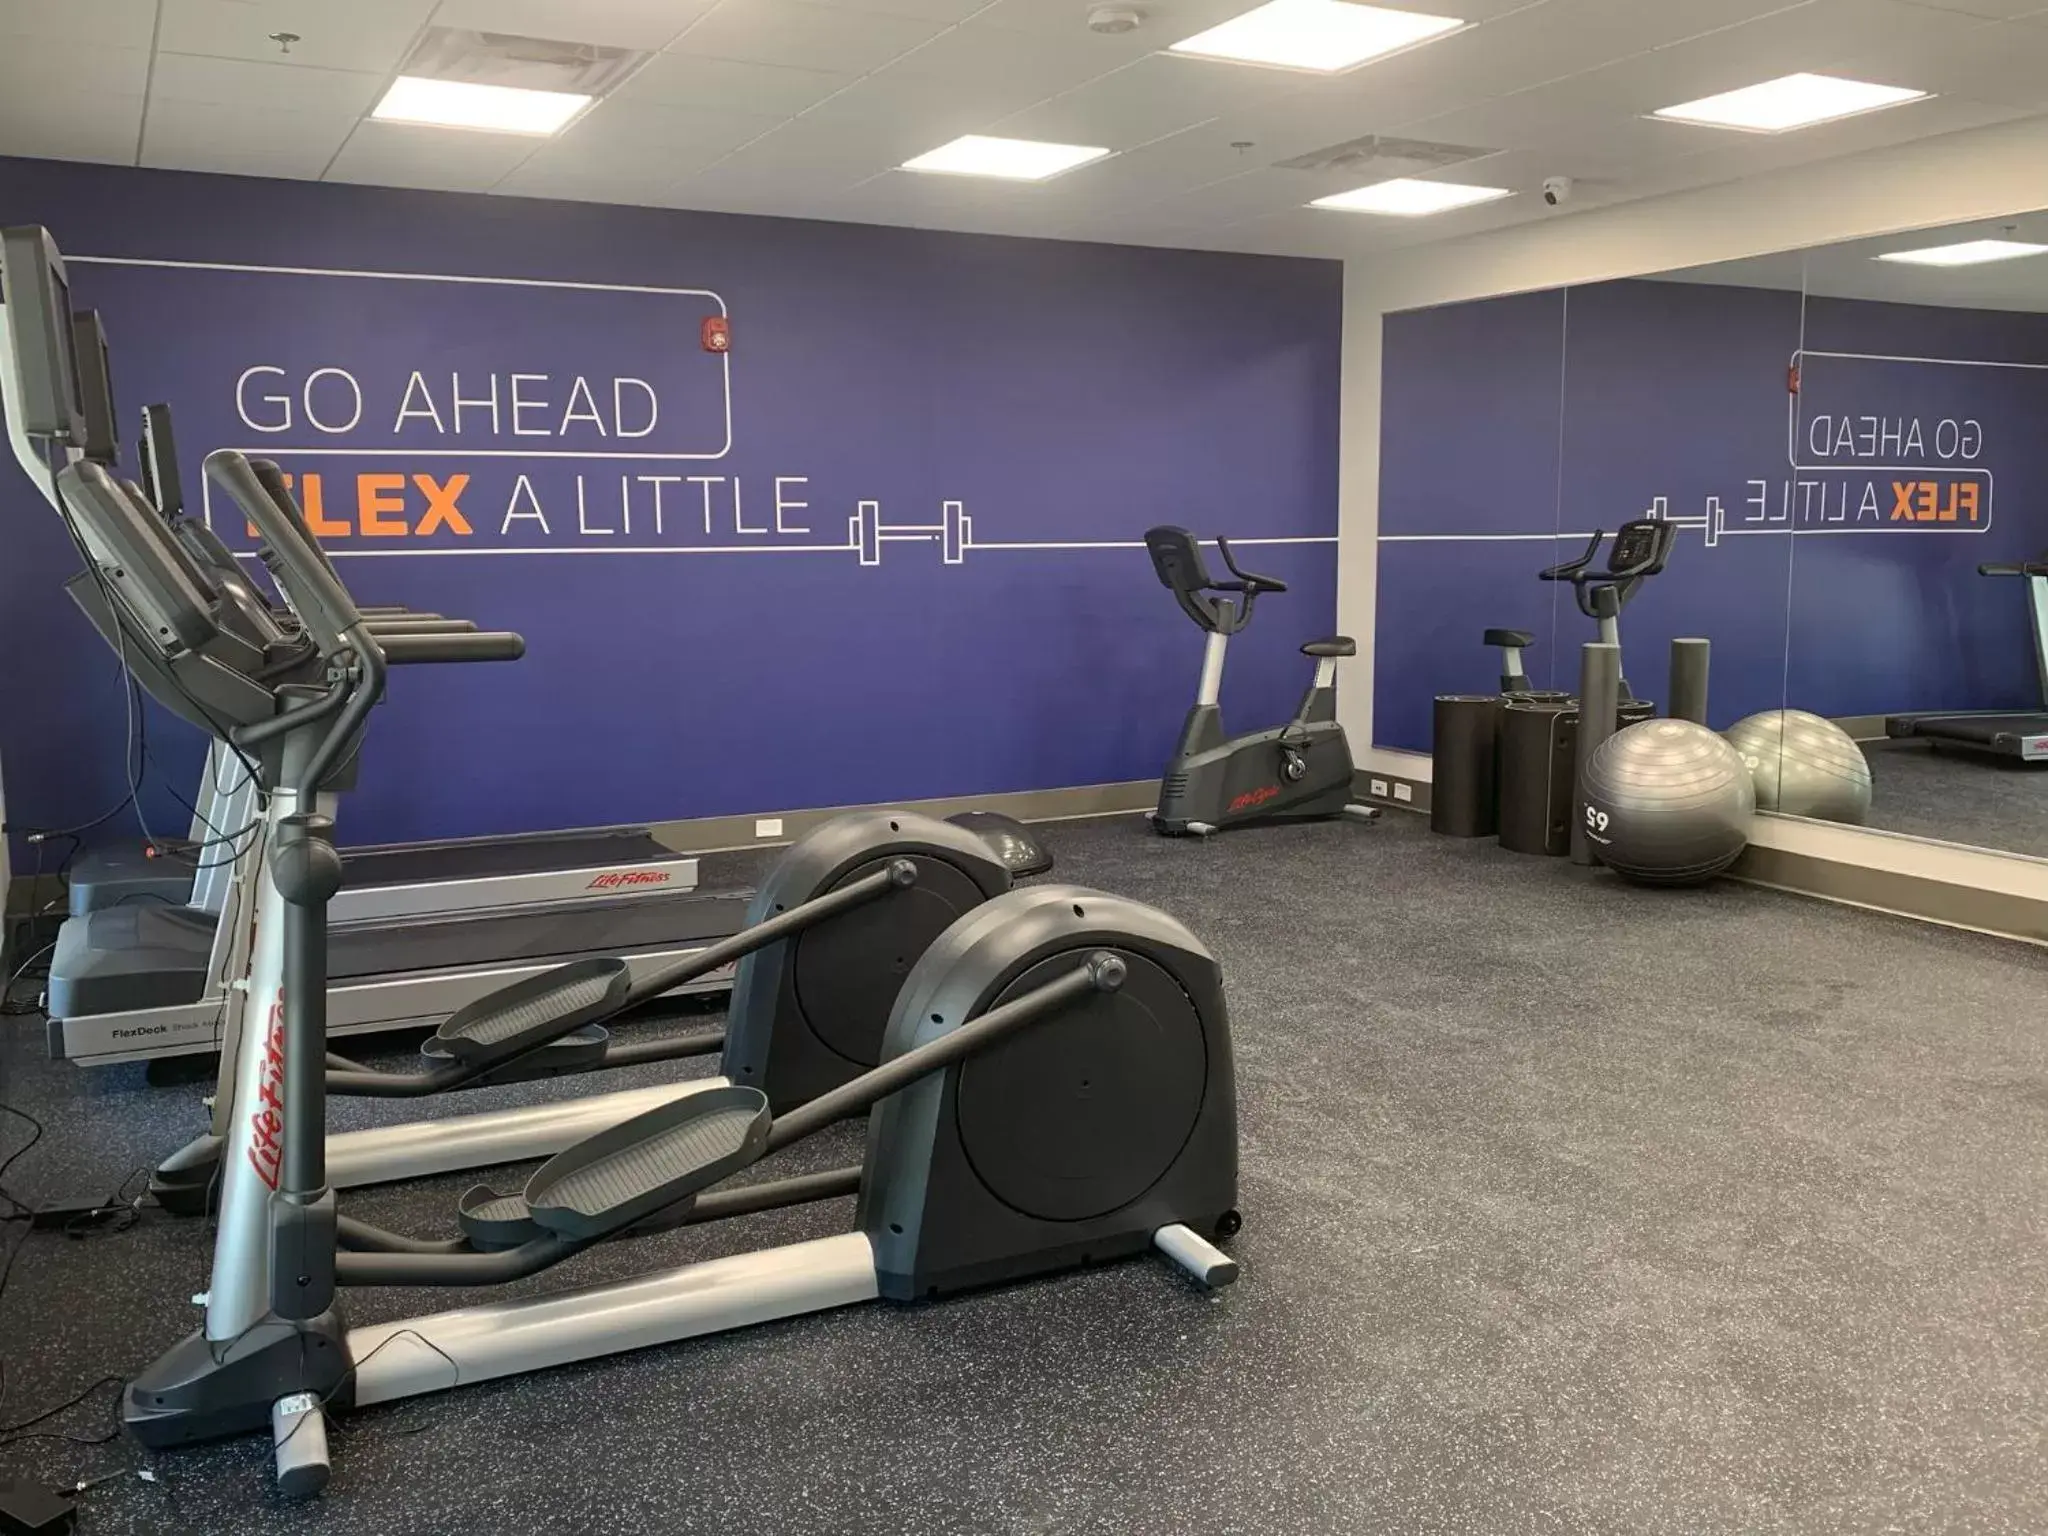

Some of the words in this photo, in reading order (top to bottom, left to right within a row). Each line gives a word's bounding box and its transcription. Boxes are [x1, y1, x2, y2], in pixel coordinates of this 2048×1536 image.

[236, 365, 362, 433] GO
[394, 370, 659, 438] AHEAD
[247, 473, 473, 537] LEX
[500, 474, 550, 536] A
[577, 474, 812, 535] LITTLE
